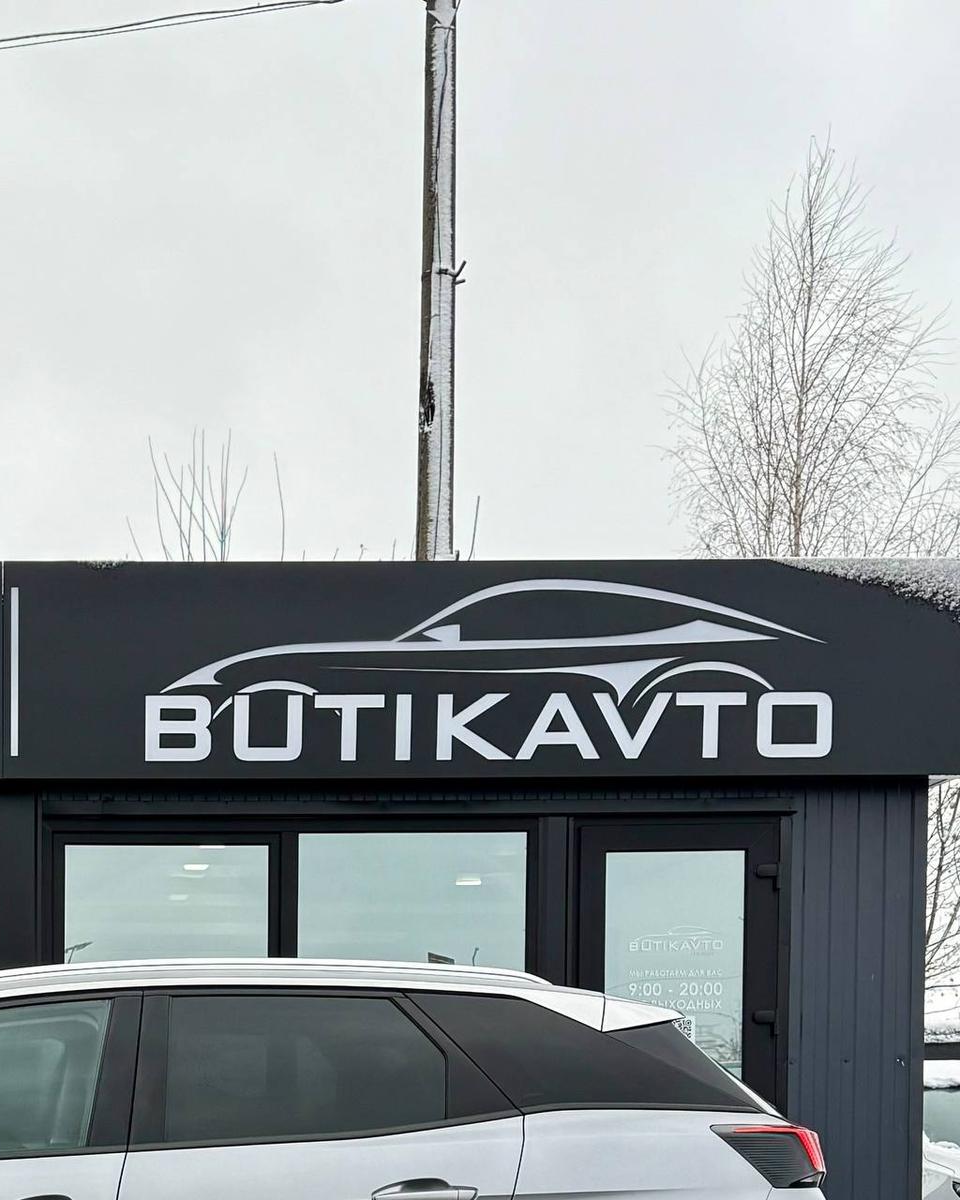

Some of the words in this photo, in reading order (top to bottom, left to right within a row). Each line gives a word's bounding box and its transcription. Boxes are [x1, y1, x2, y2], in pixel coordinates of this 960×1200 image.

[145, 691, 833, 761] BUTIKAVTO
[629, 940, 723, 951] BUTIKAVTO
[629, 982, 662, 996] 9:00
[679, 982, 722, 996] 20:00
